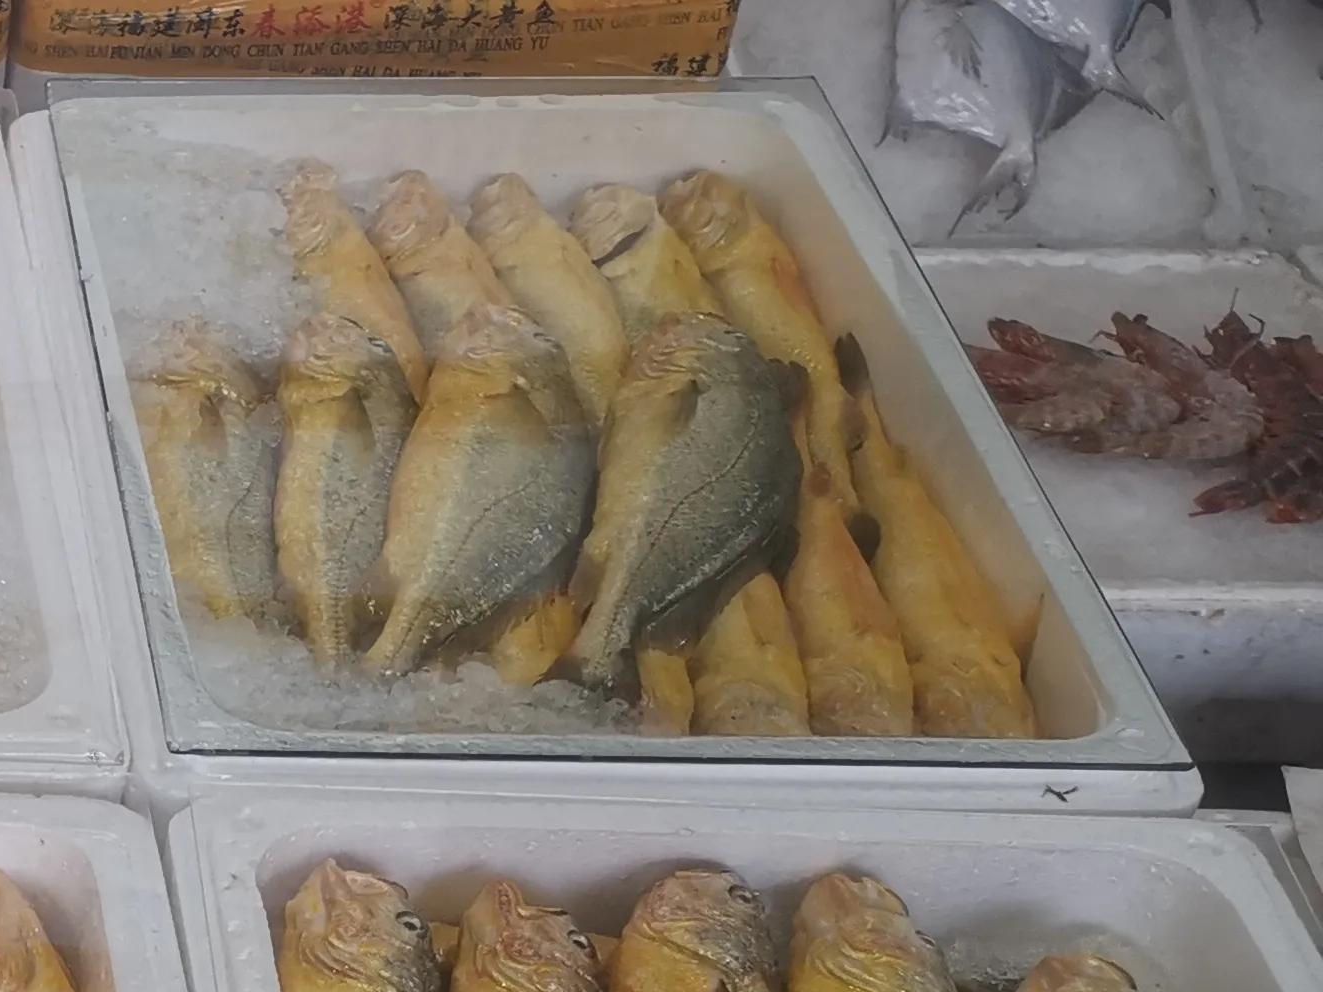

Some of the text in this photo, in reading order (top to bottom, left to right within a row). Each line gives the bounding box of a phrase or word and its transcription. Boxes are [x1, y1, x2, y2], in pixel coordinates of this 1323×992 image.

[247, 43, 284, 57] CHUN
[293, 42, 325, 56] TIAN
[330, 41, 368, 56] GANG
[417, 39, 442, 53] HAI
[449, 39, 467, 53] DA
[475, 37, 523, 51] HUANG
[530, 36, 550, 50] YU
